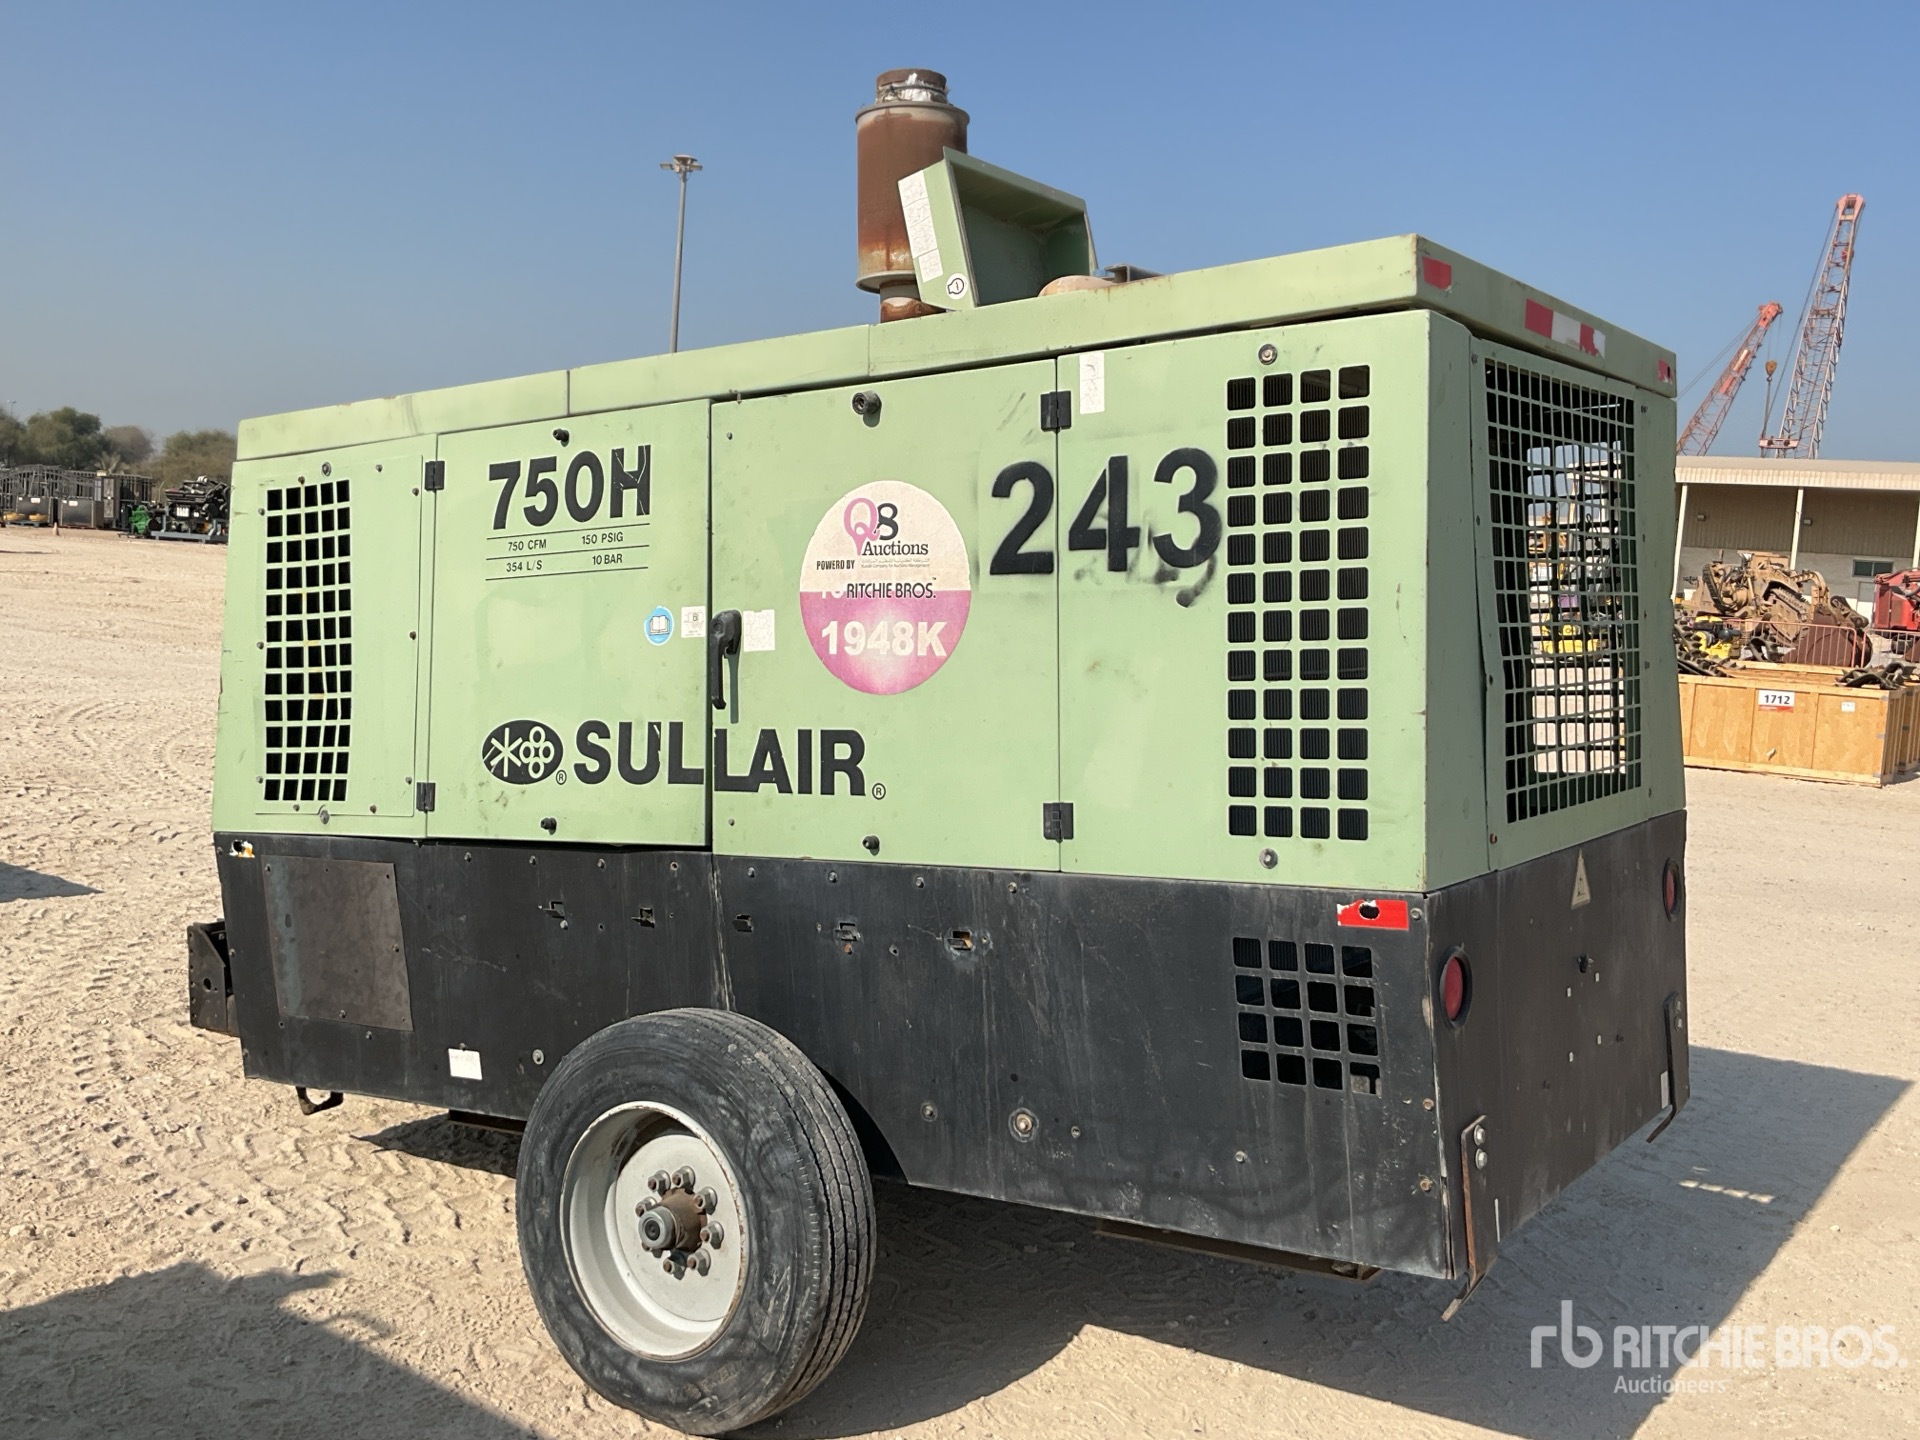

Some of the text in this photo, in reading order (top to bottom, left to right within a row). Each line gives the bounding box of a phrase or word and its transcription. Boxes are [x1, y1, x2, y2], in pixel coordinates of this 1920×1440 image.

[489, 445, 651, 530] 750H
[990, 447, 1222, 576] 243
[508, 539, 547, 551] 750 CFM
[582, 531, 624, 545] 150 PSIG
[862, 540, 929, 556] Auctions
[506, 560, 543, 572] 354 L/S
[592, 553, 623, 565] 10 BAR
[846, 559, 856, 569] BY
[846, 583, 892, 598] RITCHIE
[895, 582, 937, 598] BROS.
[821, 620, 948, 657] 1948K
[1764, 694, 1791, 705] 1712
[573, 719, 866, 796] SULLAIR
